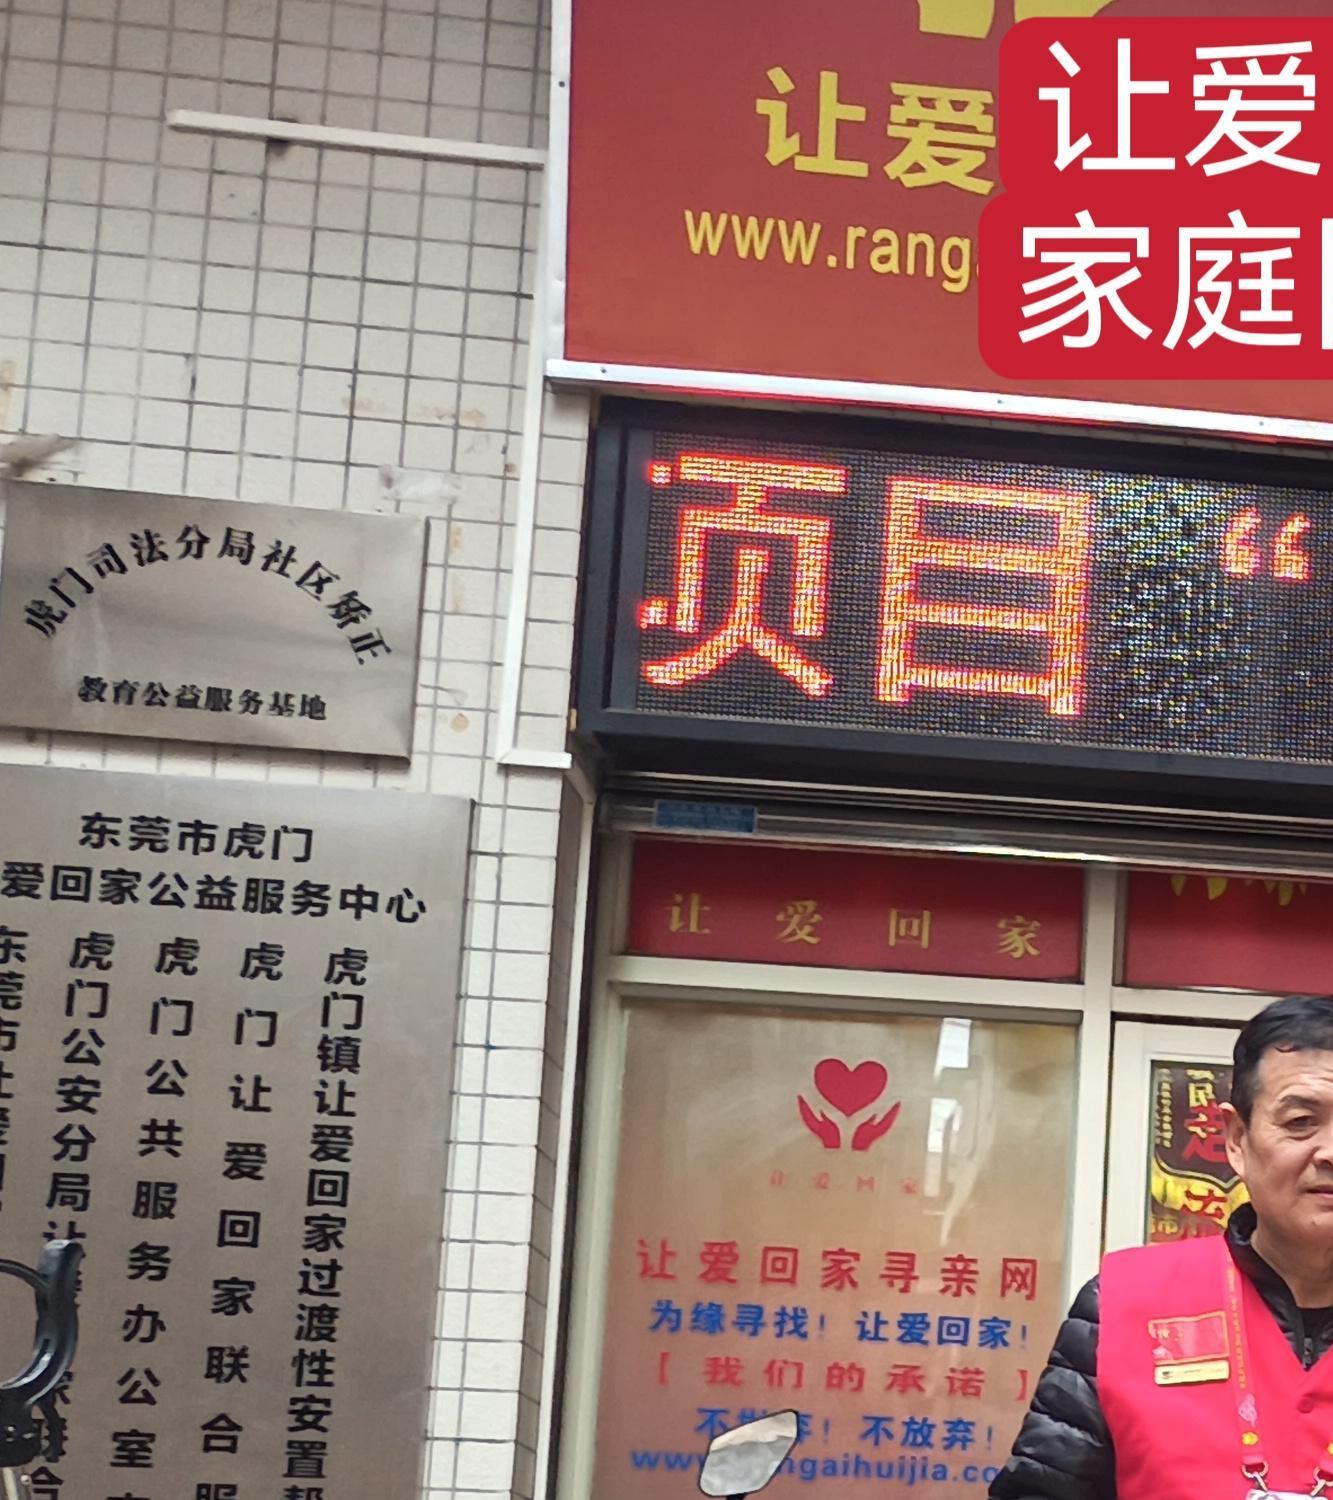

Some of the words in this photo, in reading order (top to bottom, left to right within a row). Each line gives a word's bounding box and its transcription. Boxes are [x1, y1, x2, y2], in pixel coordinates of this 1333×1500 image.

[684, 208, 979, 294] www.rang
[24, 524, 392, 665] 虎门司法分局社区矫正
[78, 675, 327, 721] 教育公益服务基地
[79, 812, 314, 862] 东莞市虎门
[1, 861, 427, 923] 爱回家公益服务中心
[668, 893, 1042, 959] 让爱回家
[636, 1238, 1039, 1301] 让爱回家寻亲网
